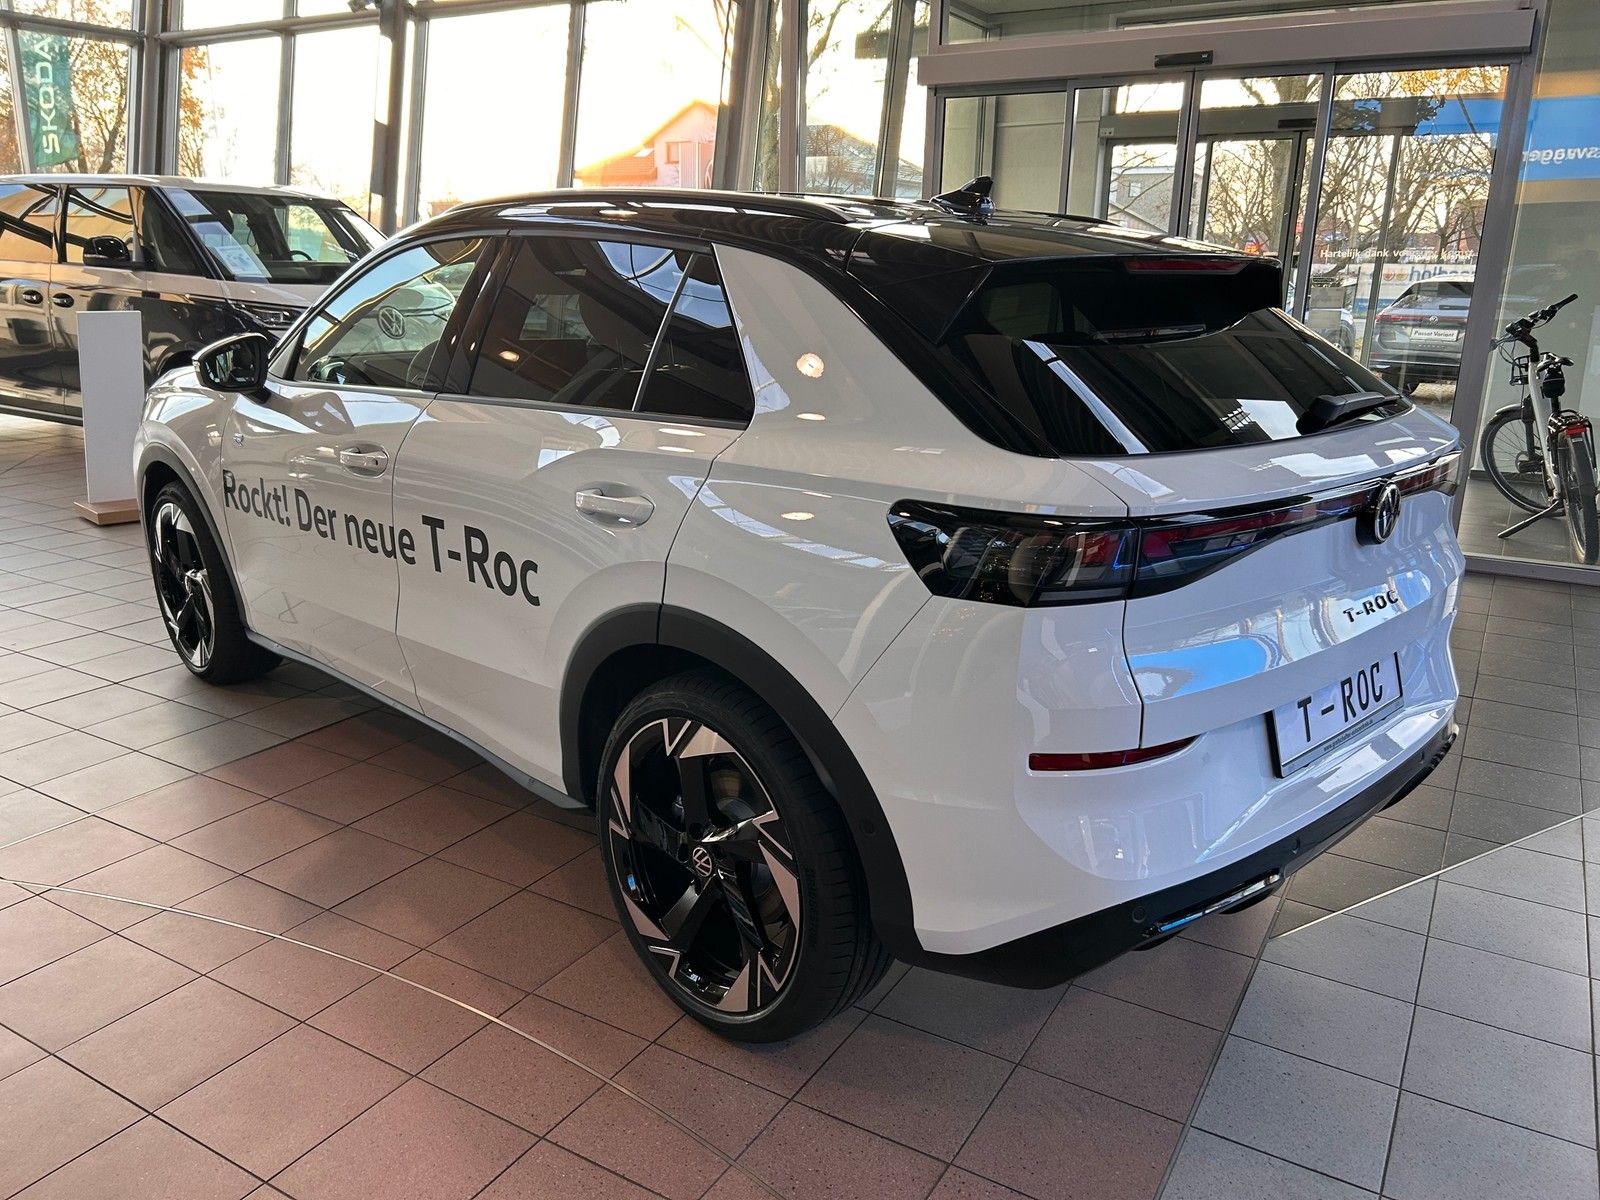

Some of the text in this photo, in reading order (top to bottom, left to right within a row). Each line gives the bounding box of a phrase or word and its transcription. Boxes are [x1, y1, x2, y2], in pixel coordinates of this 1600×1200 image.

[1320, 248, 1361, 260] Hartelijk
[1366, 248, 1389, 258] dank
[222, 469, 541, 607] Rockt! Der neue T-Roc
[1343, 590, 1399, 623] T-ROC
